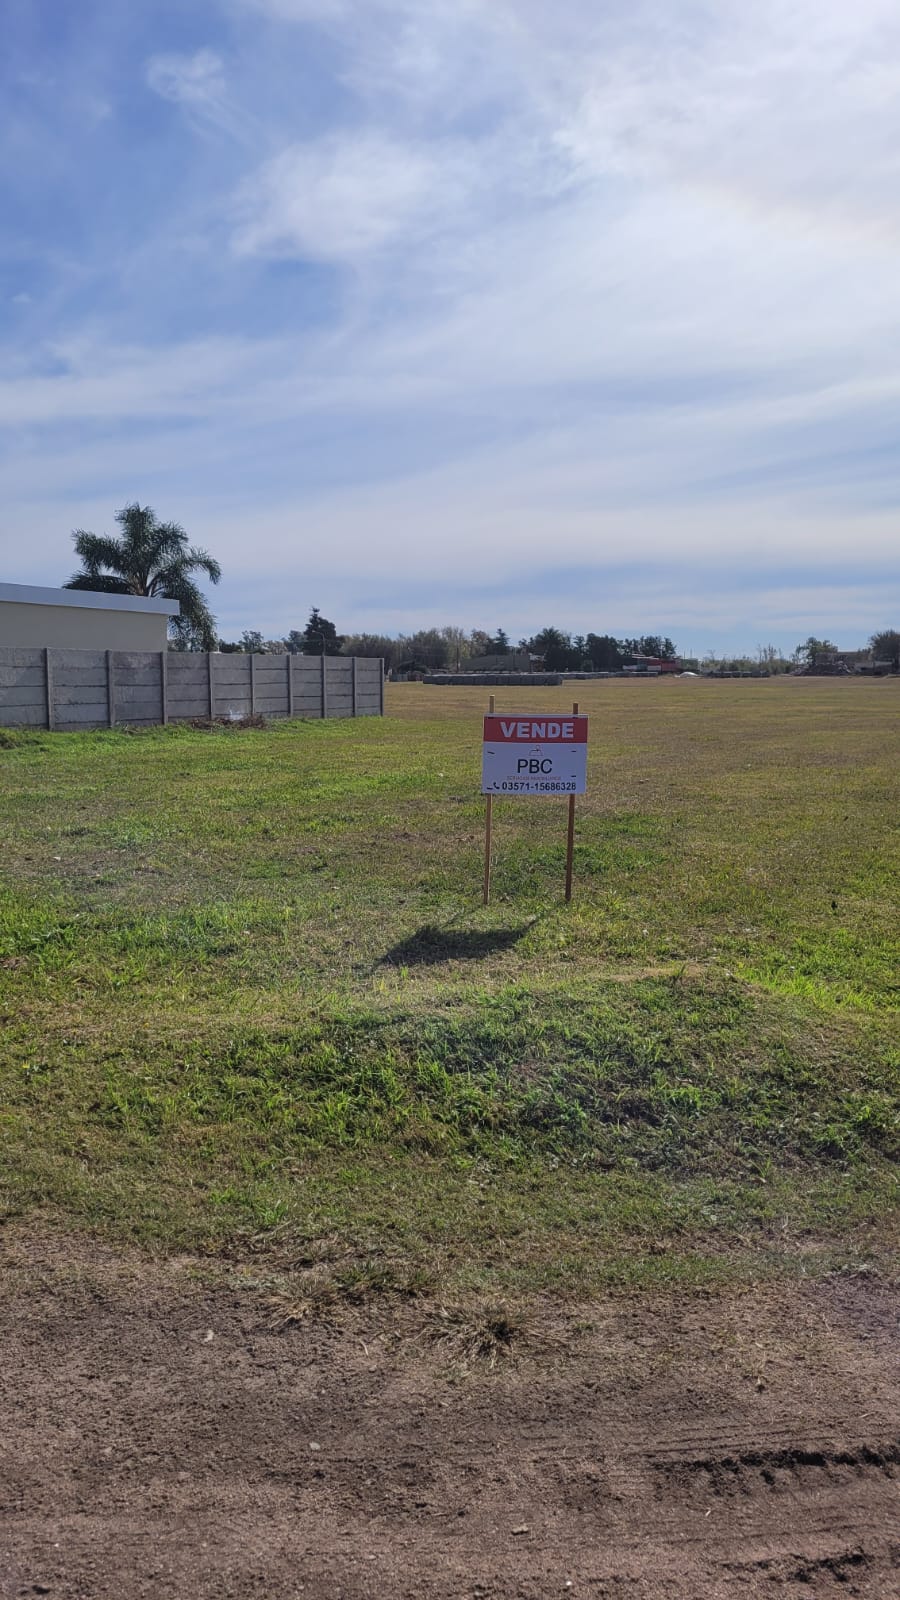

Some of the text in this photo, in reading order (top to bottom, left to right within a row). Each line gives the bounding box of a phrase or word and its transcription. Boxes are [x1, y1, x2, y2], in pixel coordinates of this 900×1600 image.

[500, 722, 574, 738] VENDE
[517, 759, 553, 774] PBC
[502, 782, 577, 791] 03571-15686328
